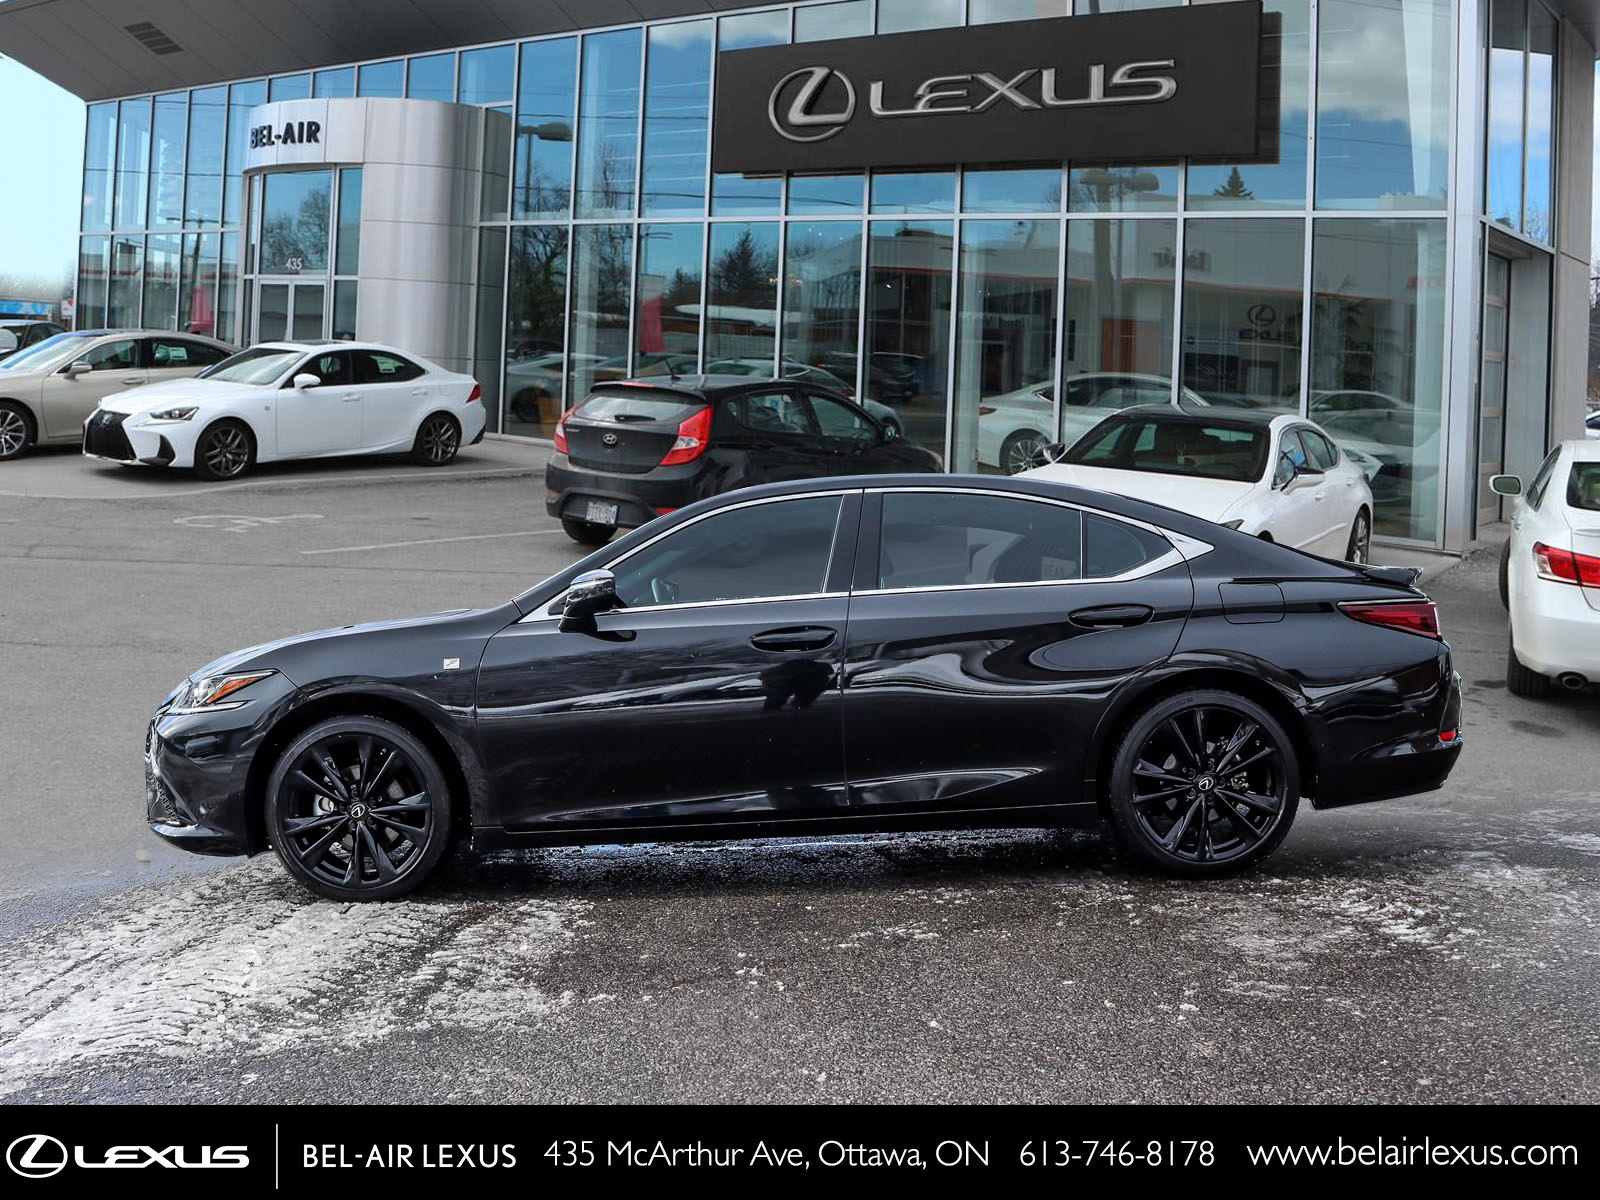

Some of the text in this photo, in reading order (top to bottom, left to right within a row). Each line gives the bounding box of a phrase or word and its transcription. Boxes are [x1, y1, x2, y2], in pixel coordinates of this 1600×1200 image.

[870, 59, 1177, 118] LEXUS
[250, 121, 321, 149] BEL-AIR
[286, 257, 302, 270] 435
